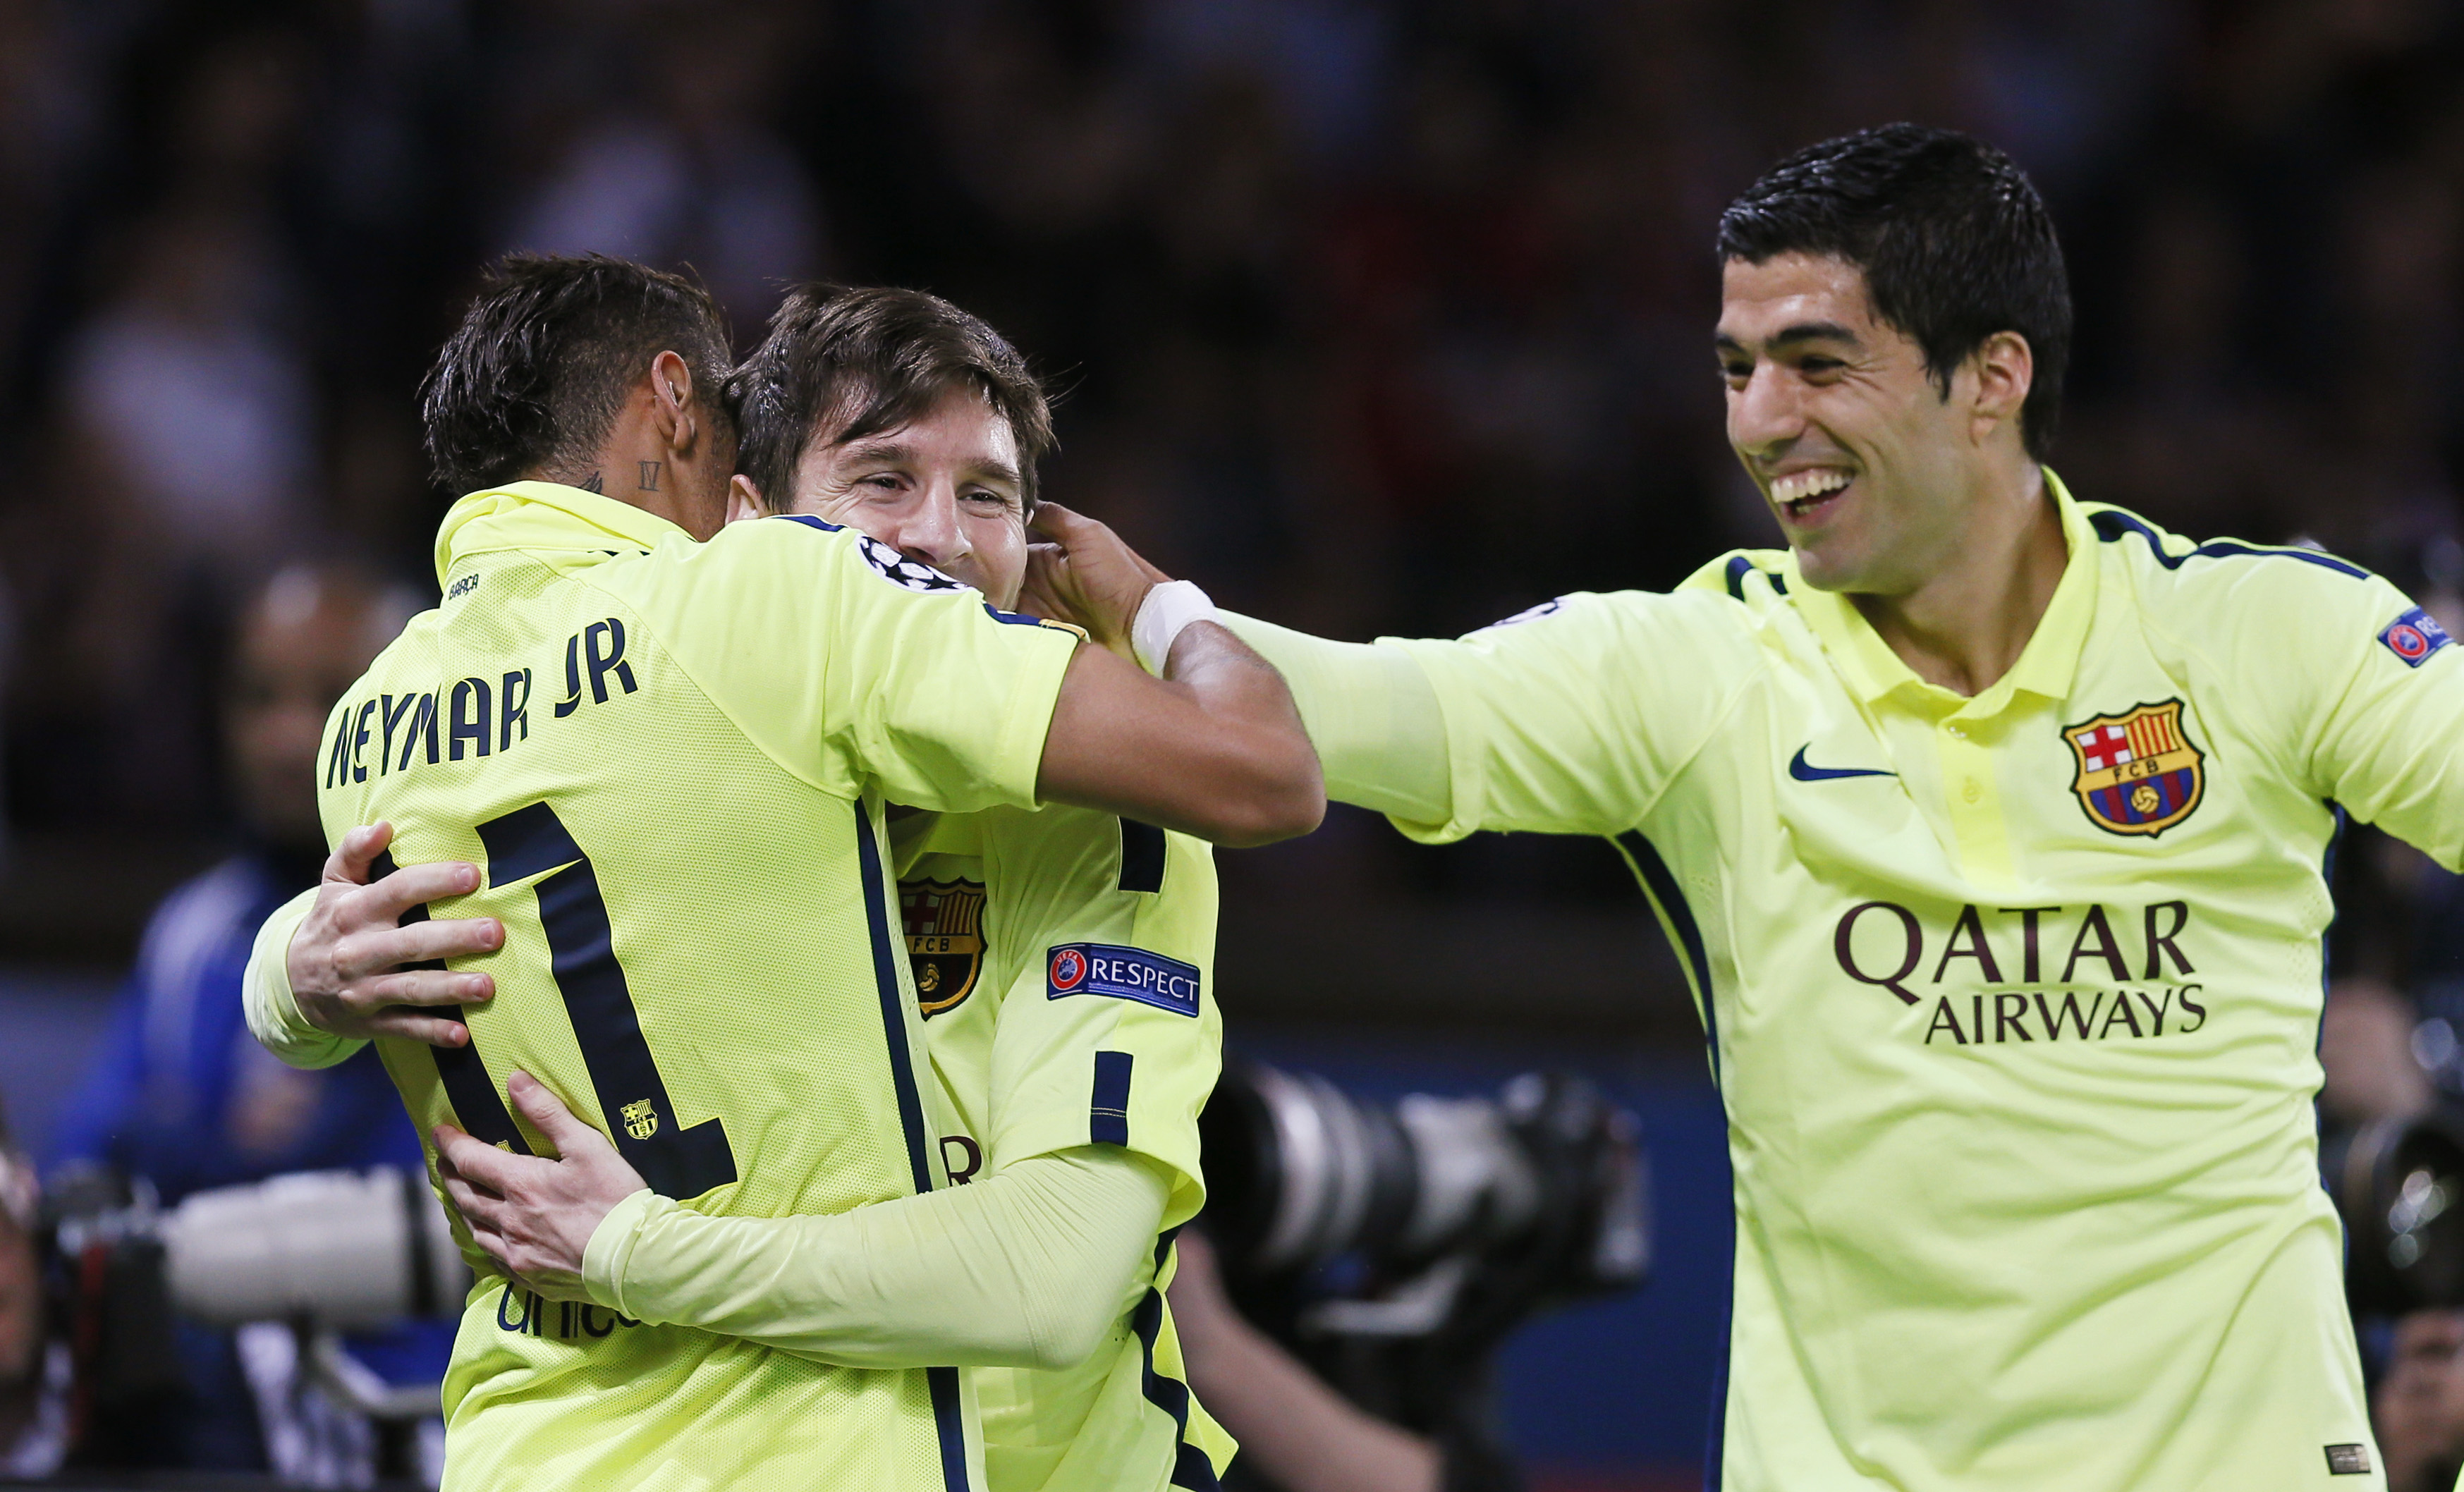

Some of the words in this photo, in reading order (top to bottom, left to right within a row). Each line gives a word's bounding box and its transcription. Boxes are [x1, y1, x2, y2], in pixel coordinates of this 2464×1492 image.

[449, 573, 479, 600] BARÇA
[326, 667, 532, 790] NEYMAR
[554, 617, 638, 719] JR
[2113, 759, 2159, 783] FCB
[913, 936, 951, 953] FCB
[1057, 952, 1078, 963] UEFA
[1834, 900, 2195, 1006] QATAR
[1092, 958, 1199, 1002] RESPECT
[1924, 984, 2207, 1045] AIRWAYS
